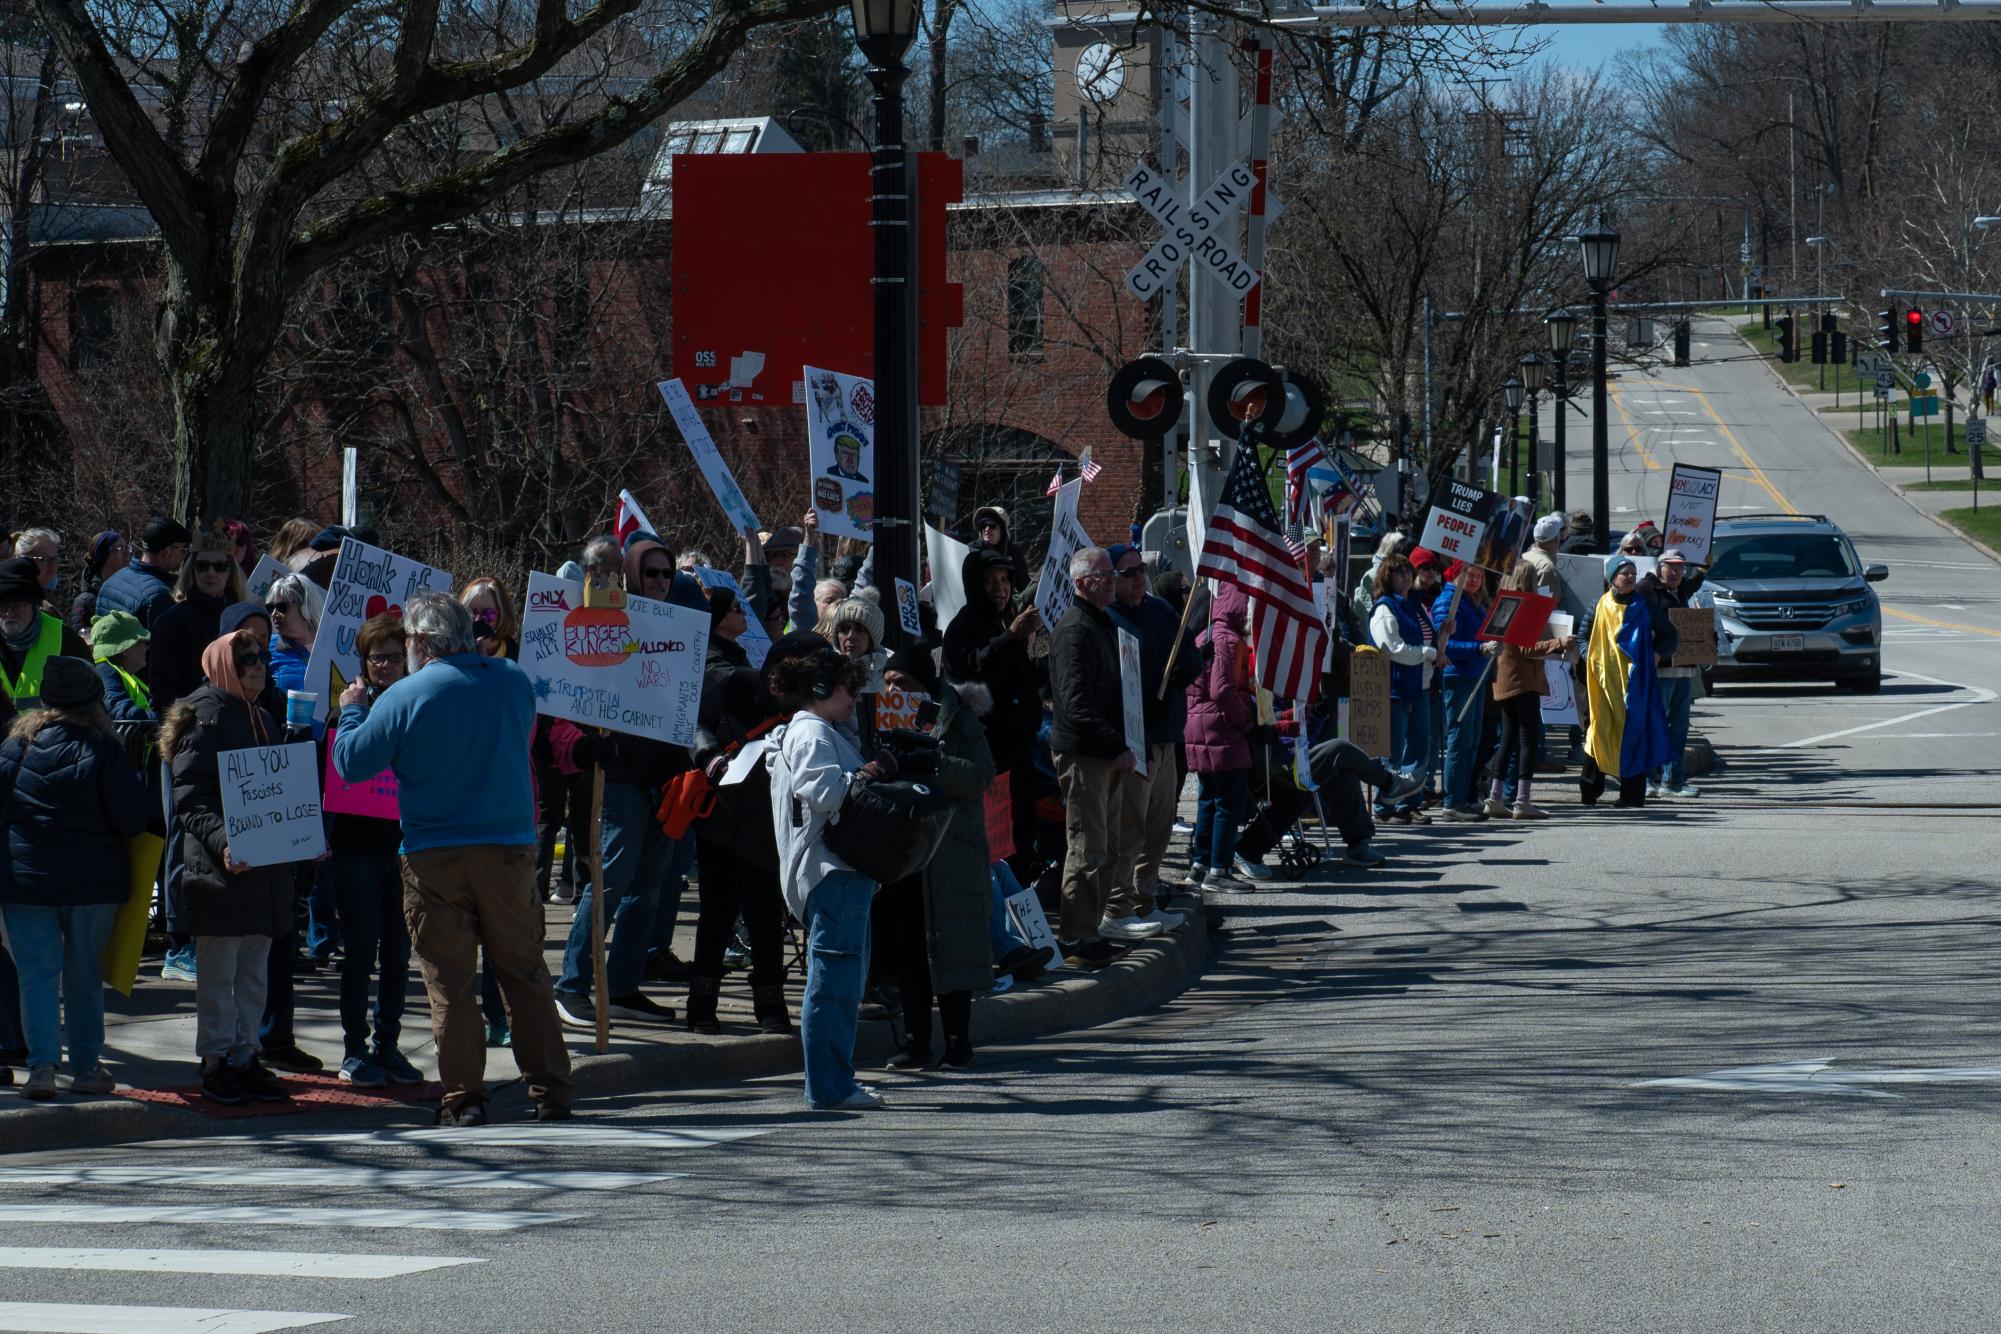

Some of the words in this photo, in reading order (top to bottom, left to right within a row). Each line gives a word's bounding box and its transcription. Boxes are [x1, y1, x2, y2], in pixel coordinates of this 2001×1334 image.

[1132, 168, 1250, 292] CROSSING
[1878, 373, 1893, 383] 43
[1968, 433, 1984, 443] 25
[1450, 482, 1483, 501] TRUMP
[1452, 498, 1472, 513] LIES
[1680, 501, 1703, 511] NOT
[1436, 513, 1477, 538] PEOPLE
[1440, 536, 1460, 552] DIE
[337, 539, 397, 594] Honk
[328, 581, 364, 619] You
[530, 589, 565, 606] ONLY
[629, 599, 648, 614] VOTE
[652, 604, 675, 618] BLUE
[906, 584, 919, 631] KINGS
[901, 606, 913, 628] NO
[564, 624, 632, 641] BURGER
[565, 639, 620, 657] KINGS
[693, 630, 707, 674] COUNTRY
[642, 660, 661, 674] NO
[1353, 655, 1387, 676] EPSTEIN
[556, 678, 620, 707] TRUMPSTEIN
[690, 680, 699, 703] OUR
[1352, 680, 1374, 697] LIVES
[875, 691, 904, 709] NO
[1351, 698, 1381, 720] TRUMPS
[570, 699, 593, 716] AND
[599, 704, 618, 720] HIS
[622, 709, 665, 729] CABINET
[672, 680, 689, 744] IMMIGRANTS
[684, 717, 694, 744] BUILT
[1357, 724, 1379, 745] HEAD
[227, 752, 255, 784] ALL
[258, 746, 290, 777] YOU
[238, 780, 284, 807] Fascists
[229, 814, 263, 838] BOUND
[265, 810, 283, 825] TO
[286, 803, 319, 821] LOSE
